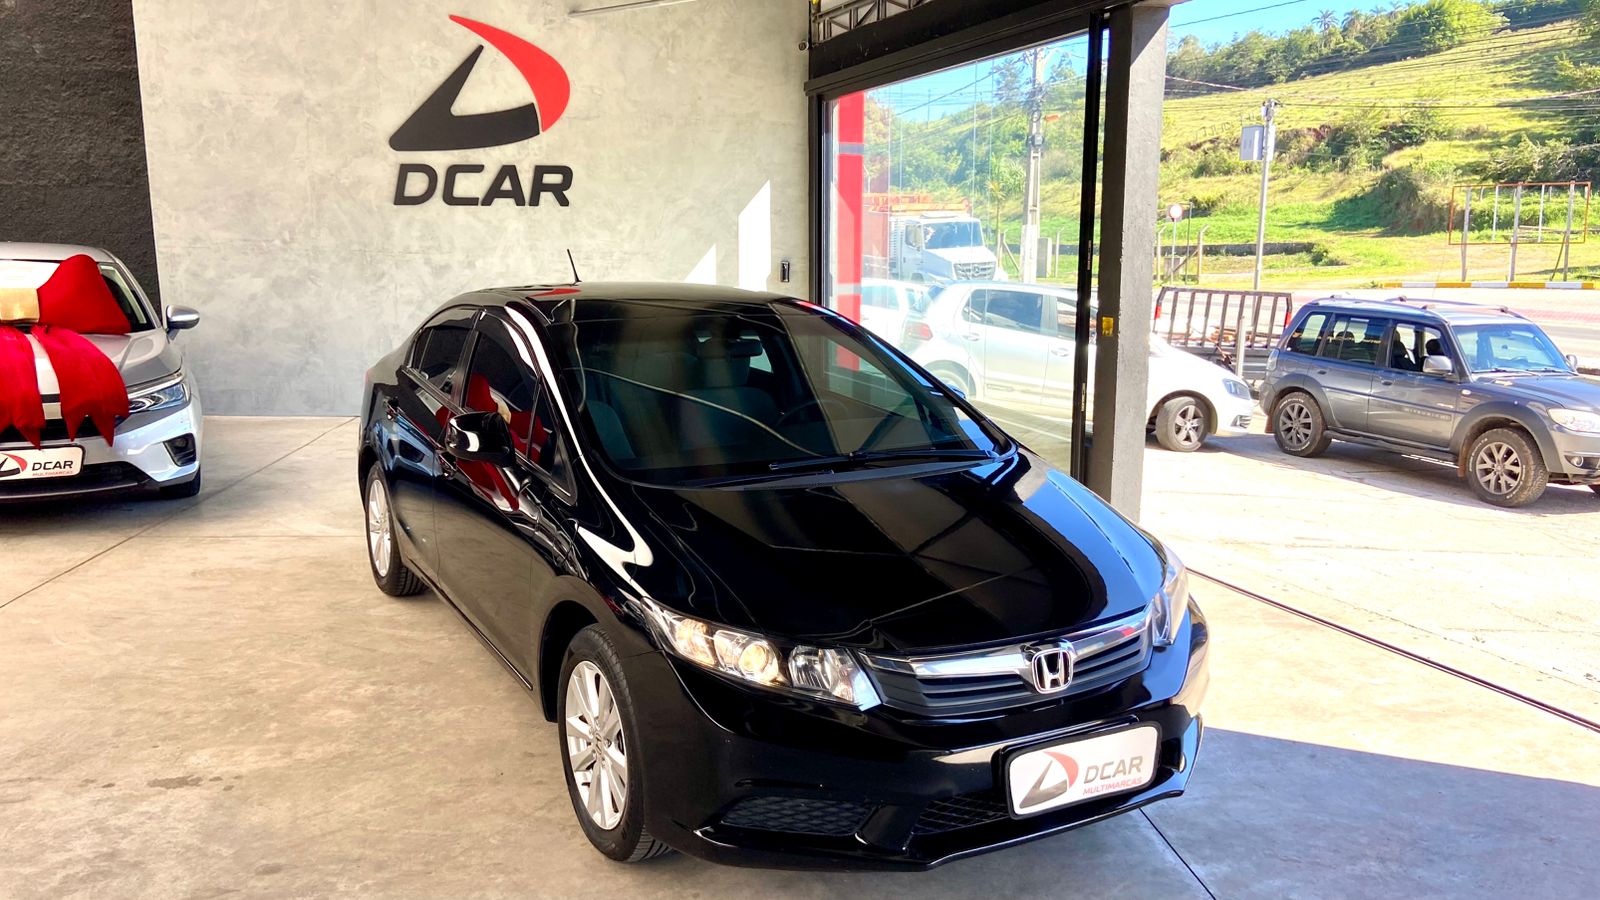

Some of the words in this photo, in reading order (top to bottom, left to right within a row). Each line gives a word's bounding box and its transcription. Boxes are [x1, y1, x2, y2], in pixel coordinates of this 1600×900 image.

[394, 163, 573, 207] DCAR
[32, 460, 73, 471] DCAR
[1083, 755, 1143, 785] DCAR
[1082, 776, 1143, 796] MULTIMARCAS
